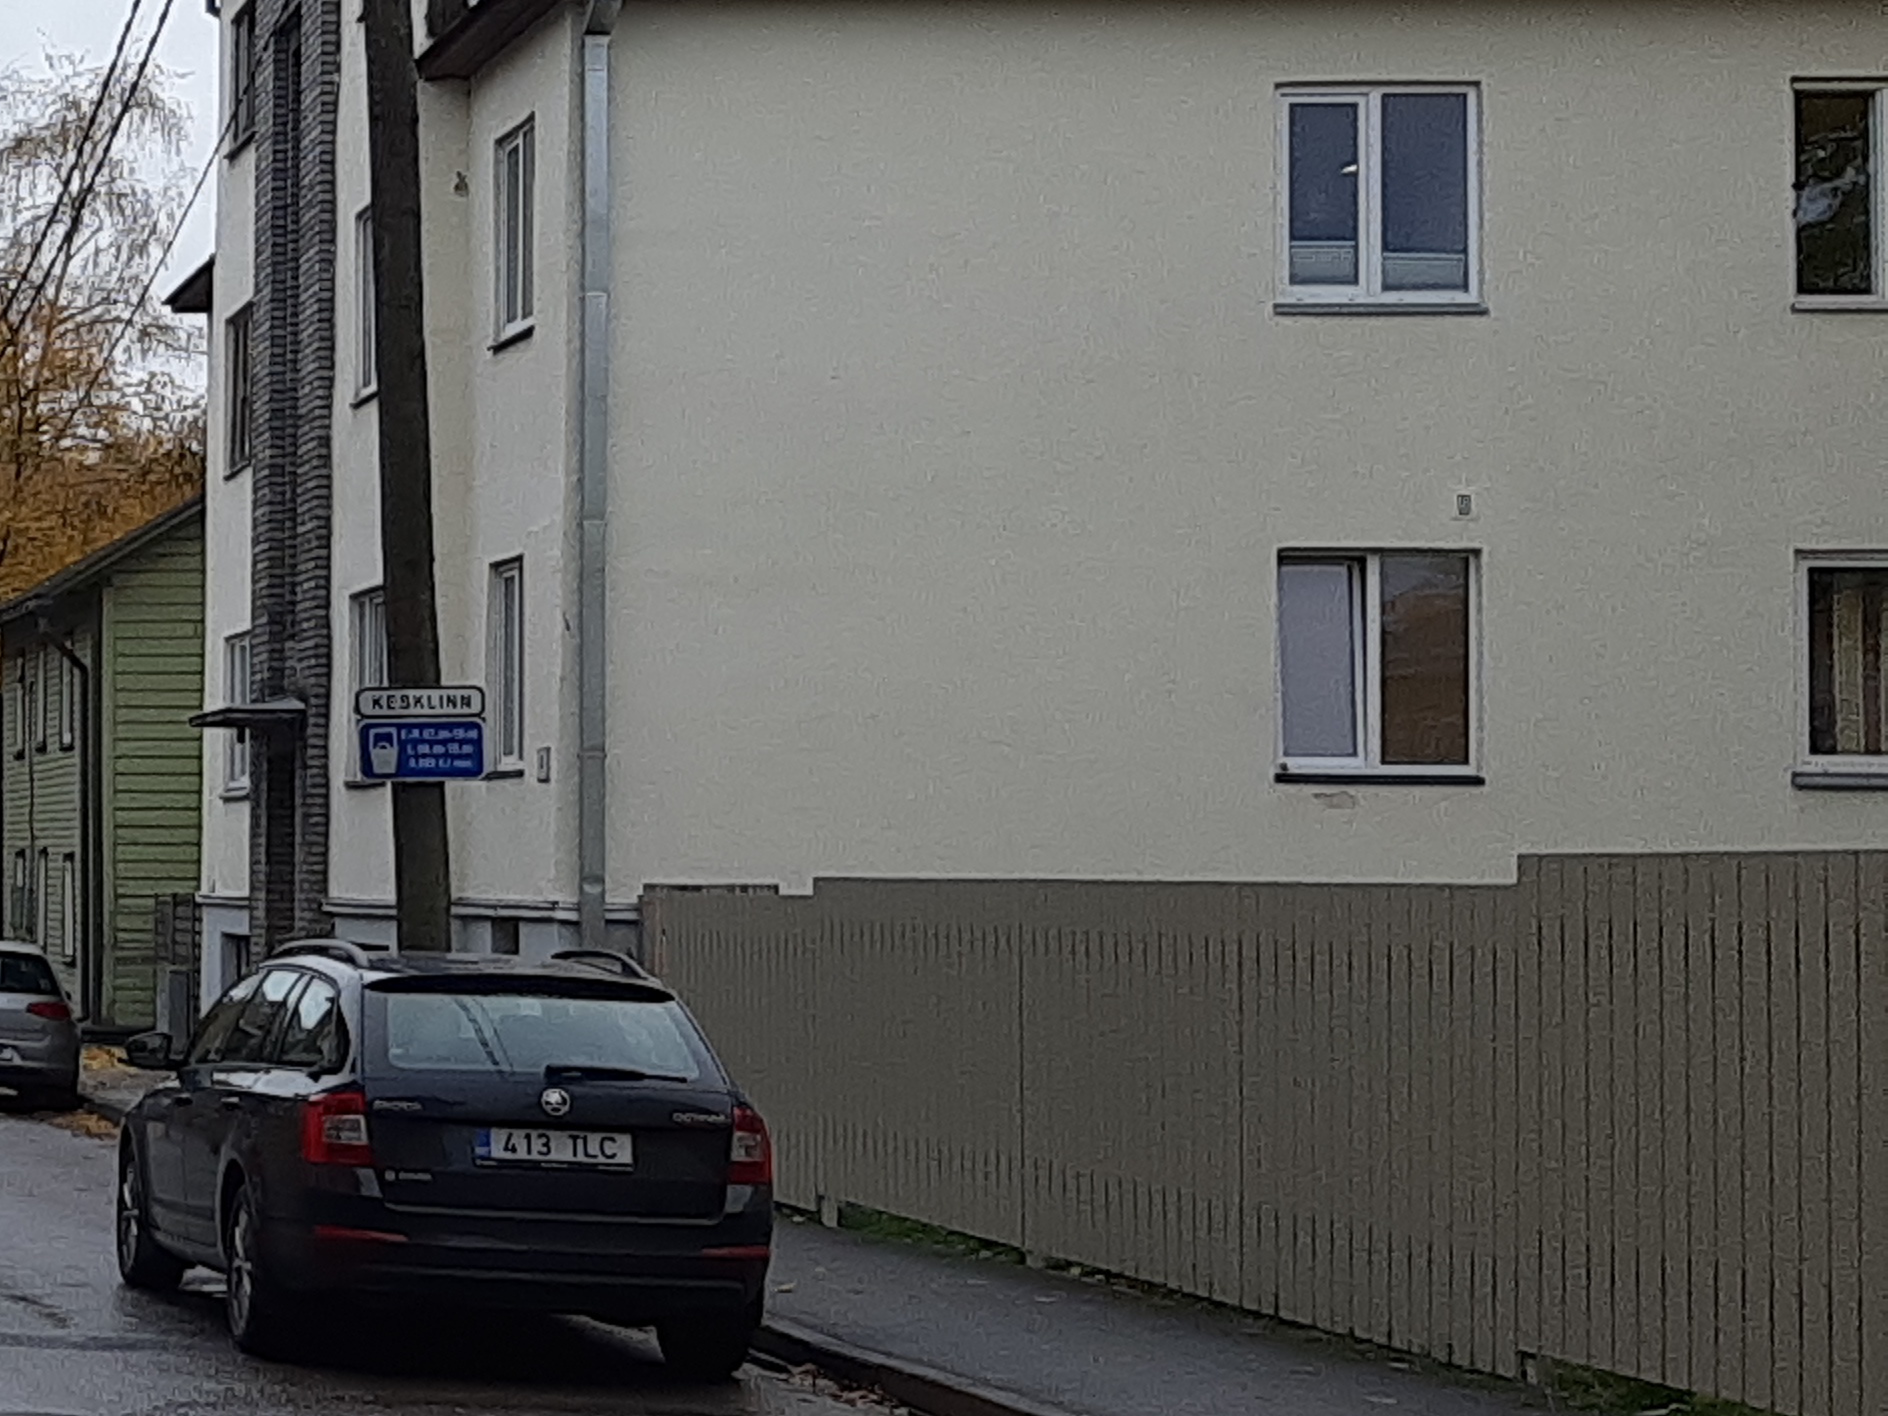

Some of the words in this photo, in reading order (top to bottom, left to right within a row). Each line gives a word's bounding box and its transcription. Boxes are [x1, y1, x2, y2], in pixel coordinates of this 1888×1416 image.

[371, 693, 473, 711] KESKLINN
[501, 1131, 553, 1157] 413
[568, 1134, 619, 1160] TLC
